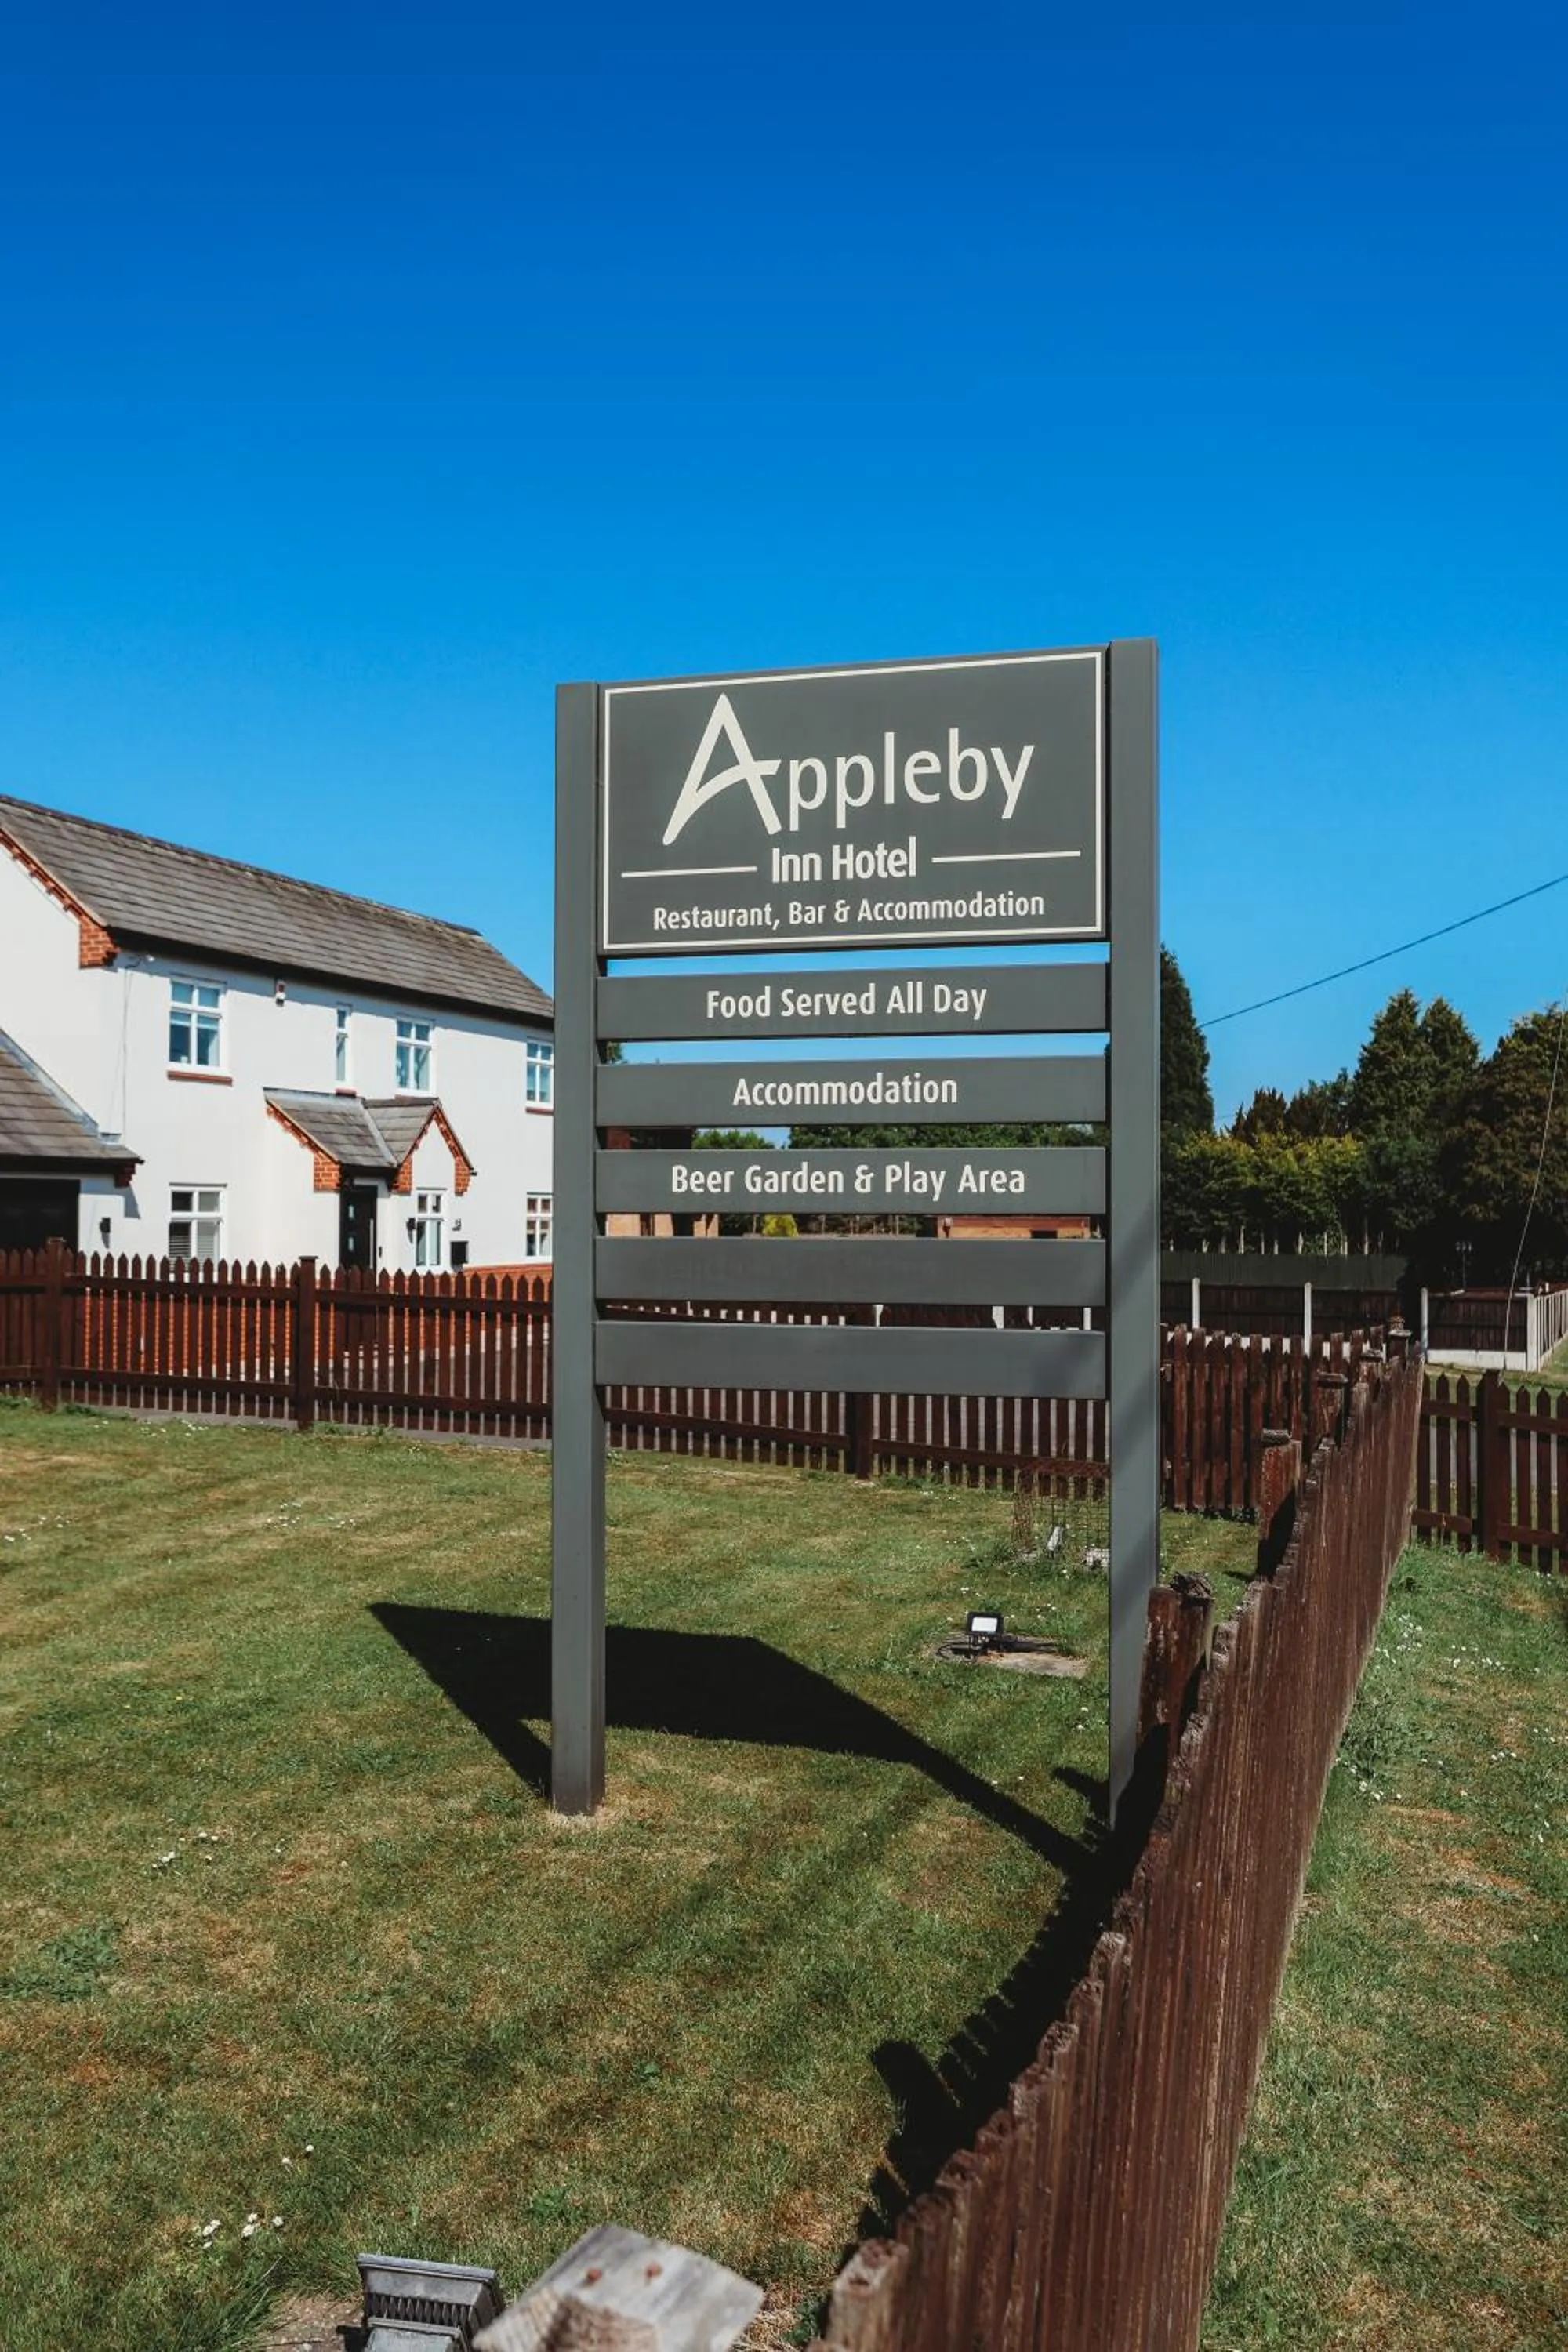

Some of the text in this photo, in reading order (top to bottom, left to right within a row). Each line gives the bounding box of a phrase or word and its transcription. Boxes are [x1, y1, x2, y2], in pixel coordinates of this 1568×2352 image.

[662, 692, 1036, 846] Appleby
[771, 835, 916, 884] Inn Hotel
[653, 890, 1045, 931] Restaurant, Bar & Accommodation
[706, 981, 988, 1021] Food Served All Day
[732, 1072, 958, 1106] Accommodation
[671, 1160, 1025, 1202] Beer Garden & Play Area
